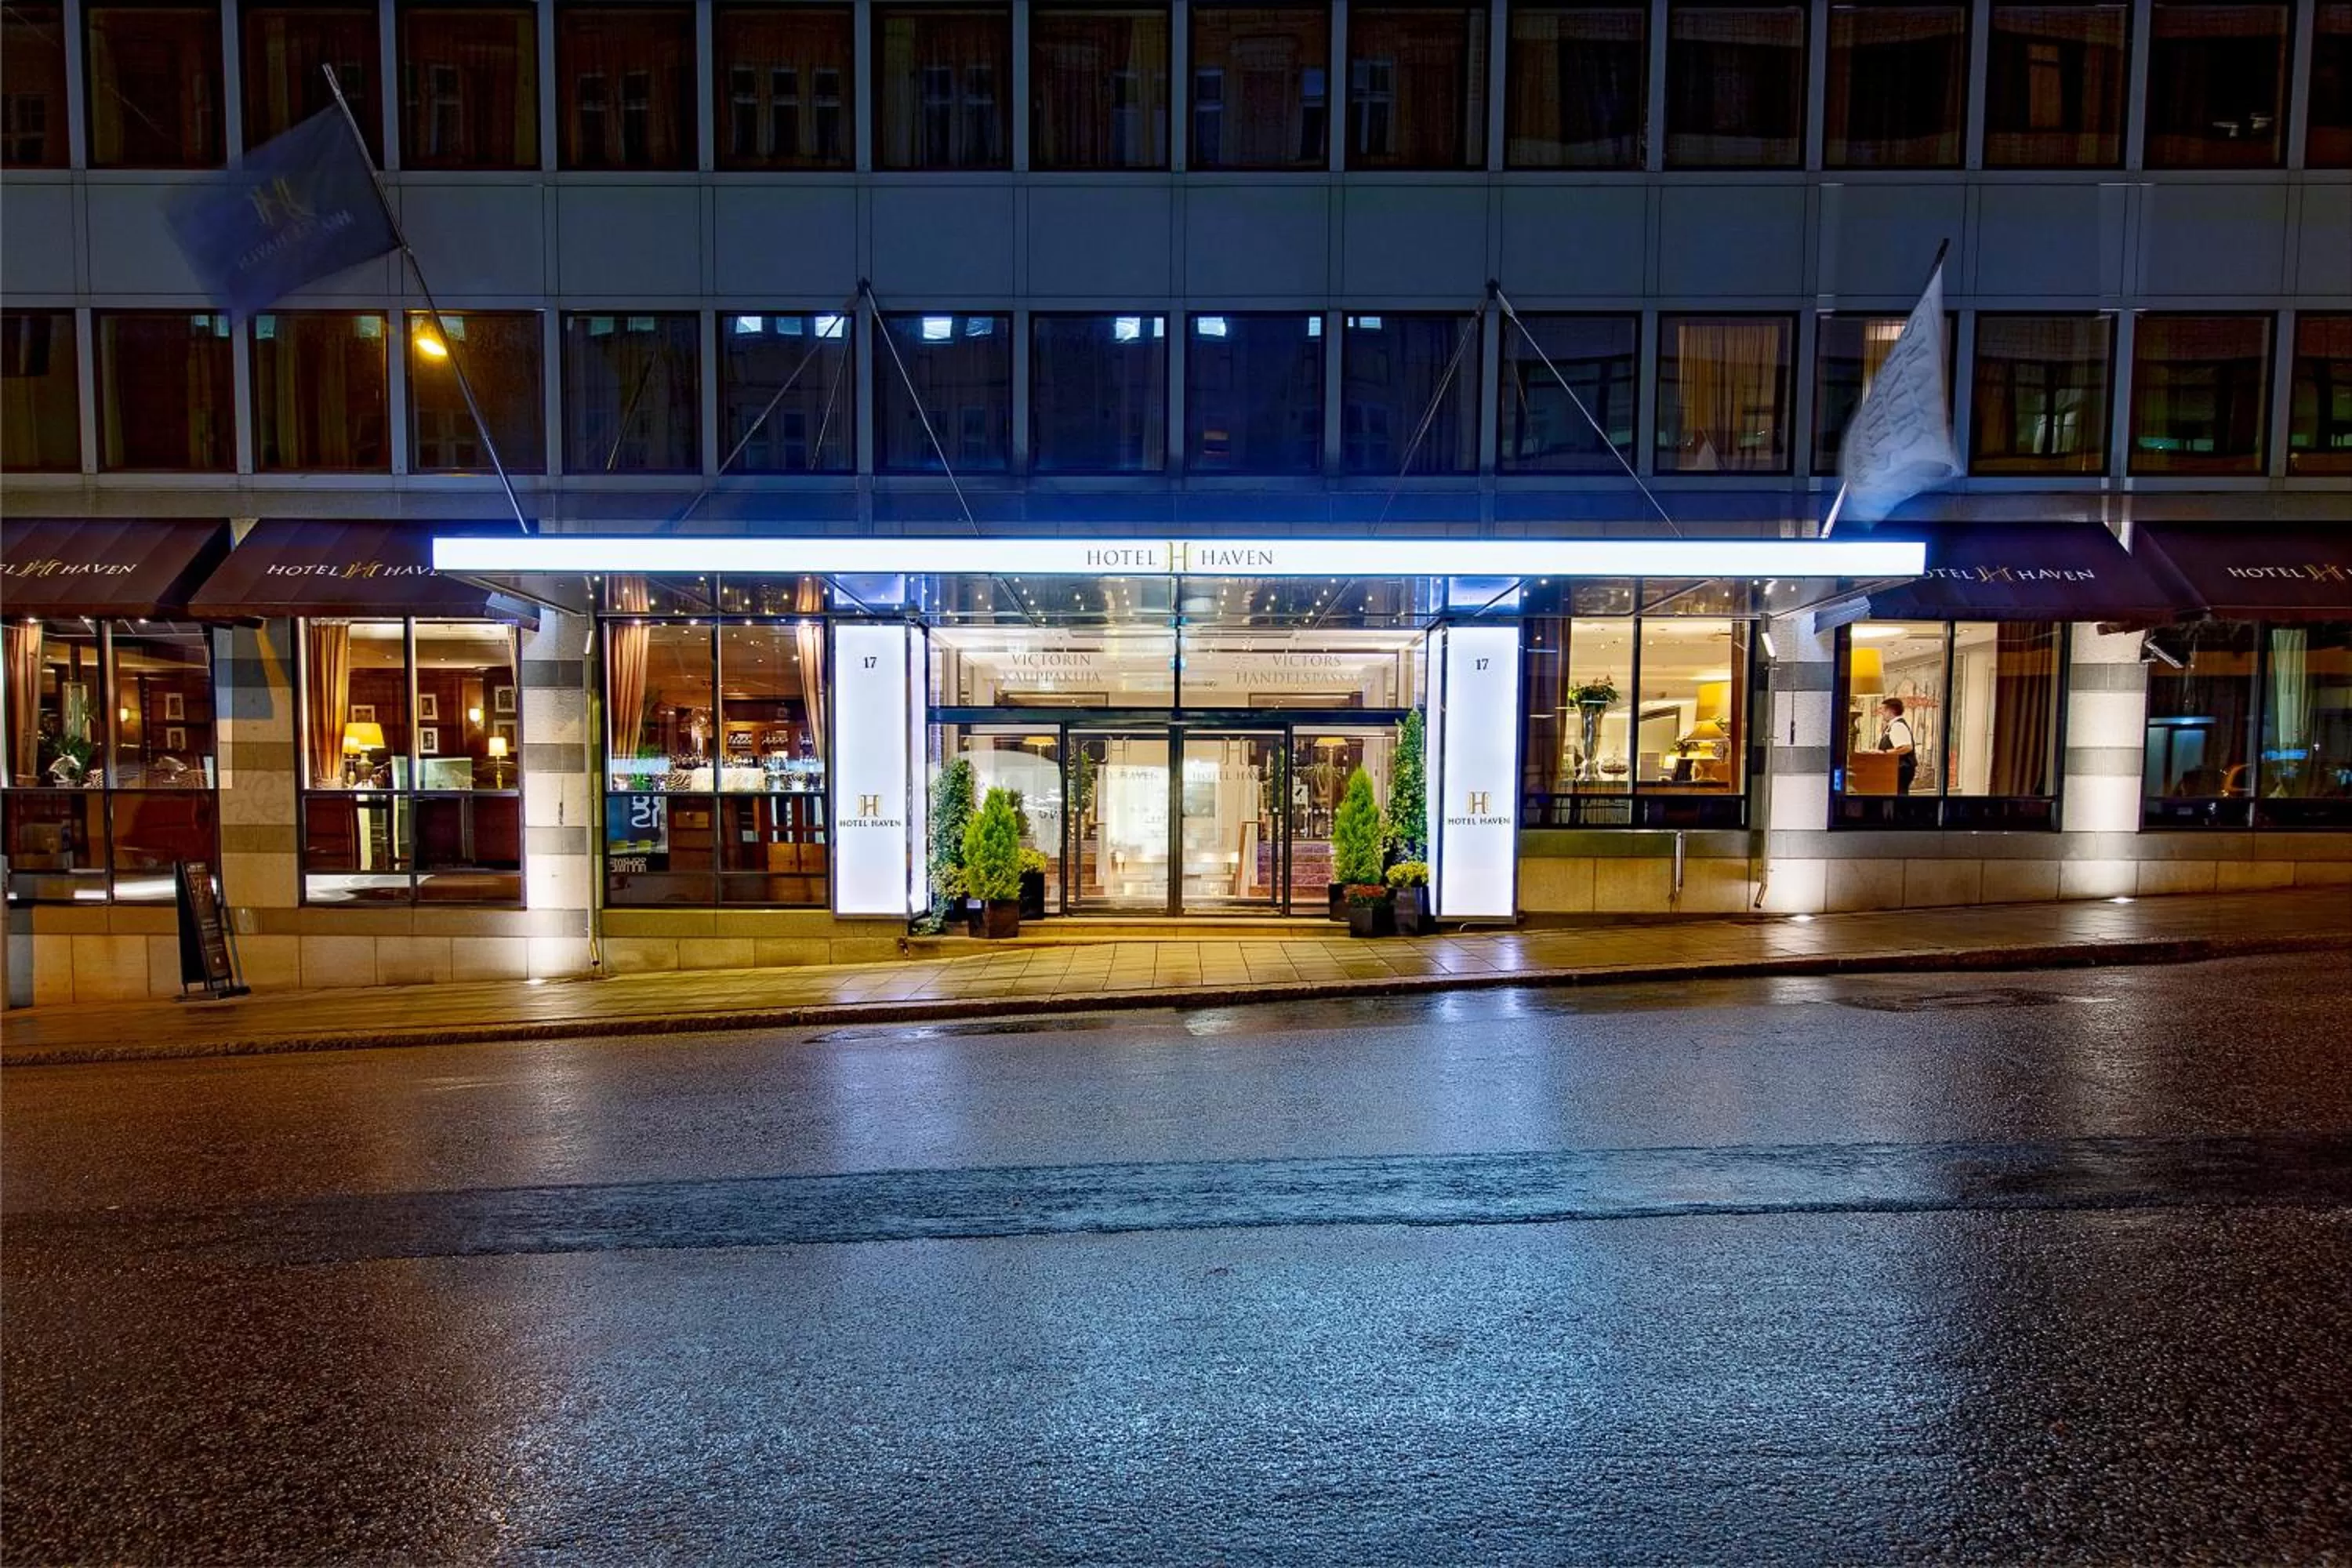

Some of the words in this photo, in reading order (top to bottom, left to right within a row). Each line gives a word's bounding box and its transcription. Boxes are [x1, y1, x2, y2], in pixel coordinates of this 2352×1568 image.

[1087, 550, 1157, 566] HOTEL
[1164, 542, 1191, 572] H
[1202, 549, 1273, 566] HAVEN
[60, 564, 137, 575] HAVEN
[266, 564, 339, 576] HOTEL
[383, 565, 441, 576] HAV
[1925, 568, 1975, 579] OTEL
[2016, 568, 2096, 581] HAVEN
[2227, 567, 2305, 578] HOTEL
[865, 656, 877, 669] 17
[1012, 654, 1091, 666] VICTORIN
[1272, 655, 1342, 666] VICTORS
[1476, 658, 1490, 670] 17
[1448, 817, 1476, 826] HOTEL
[1479, 817, 1510, 826] HAVEN
